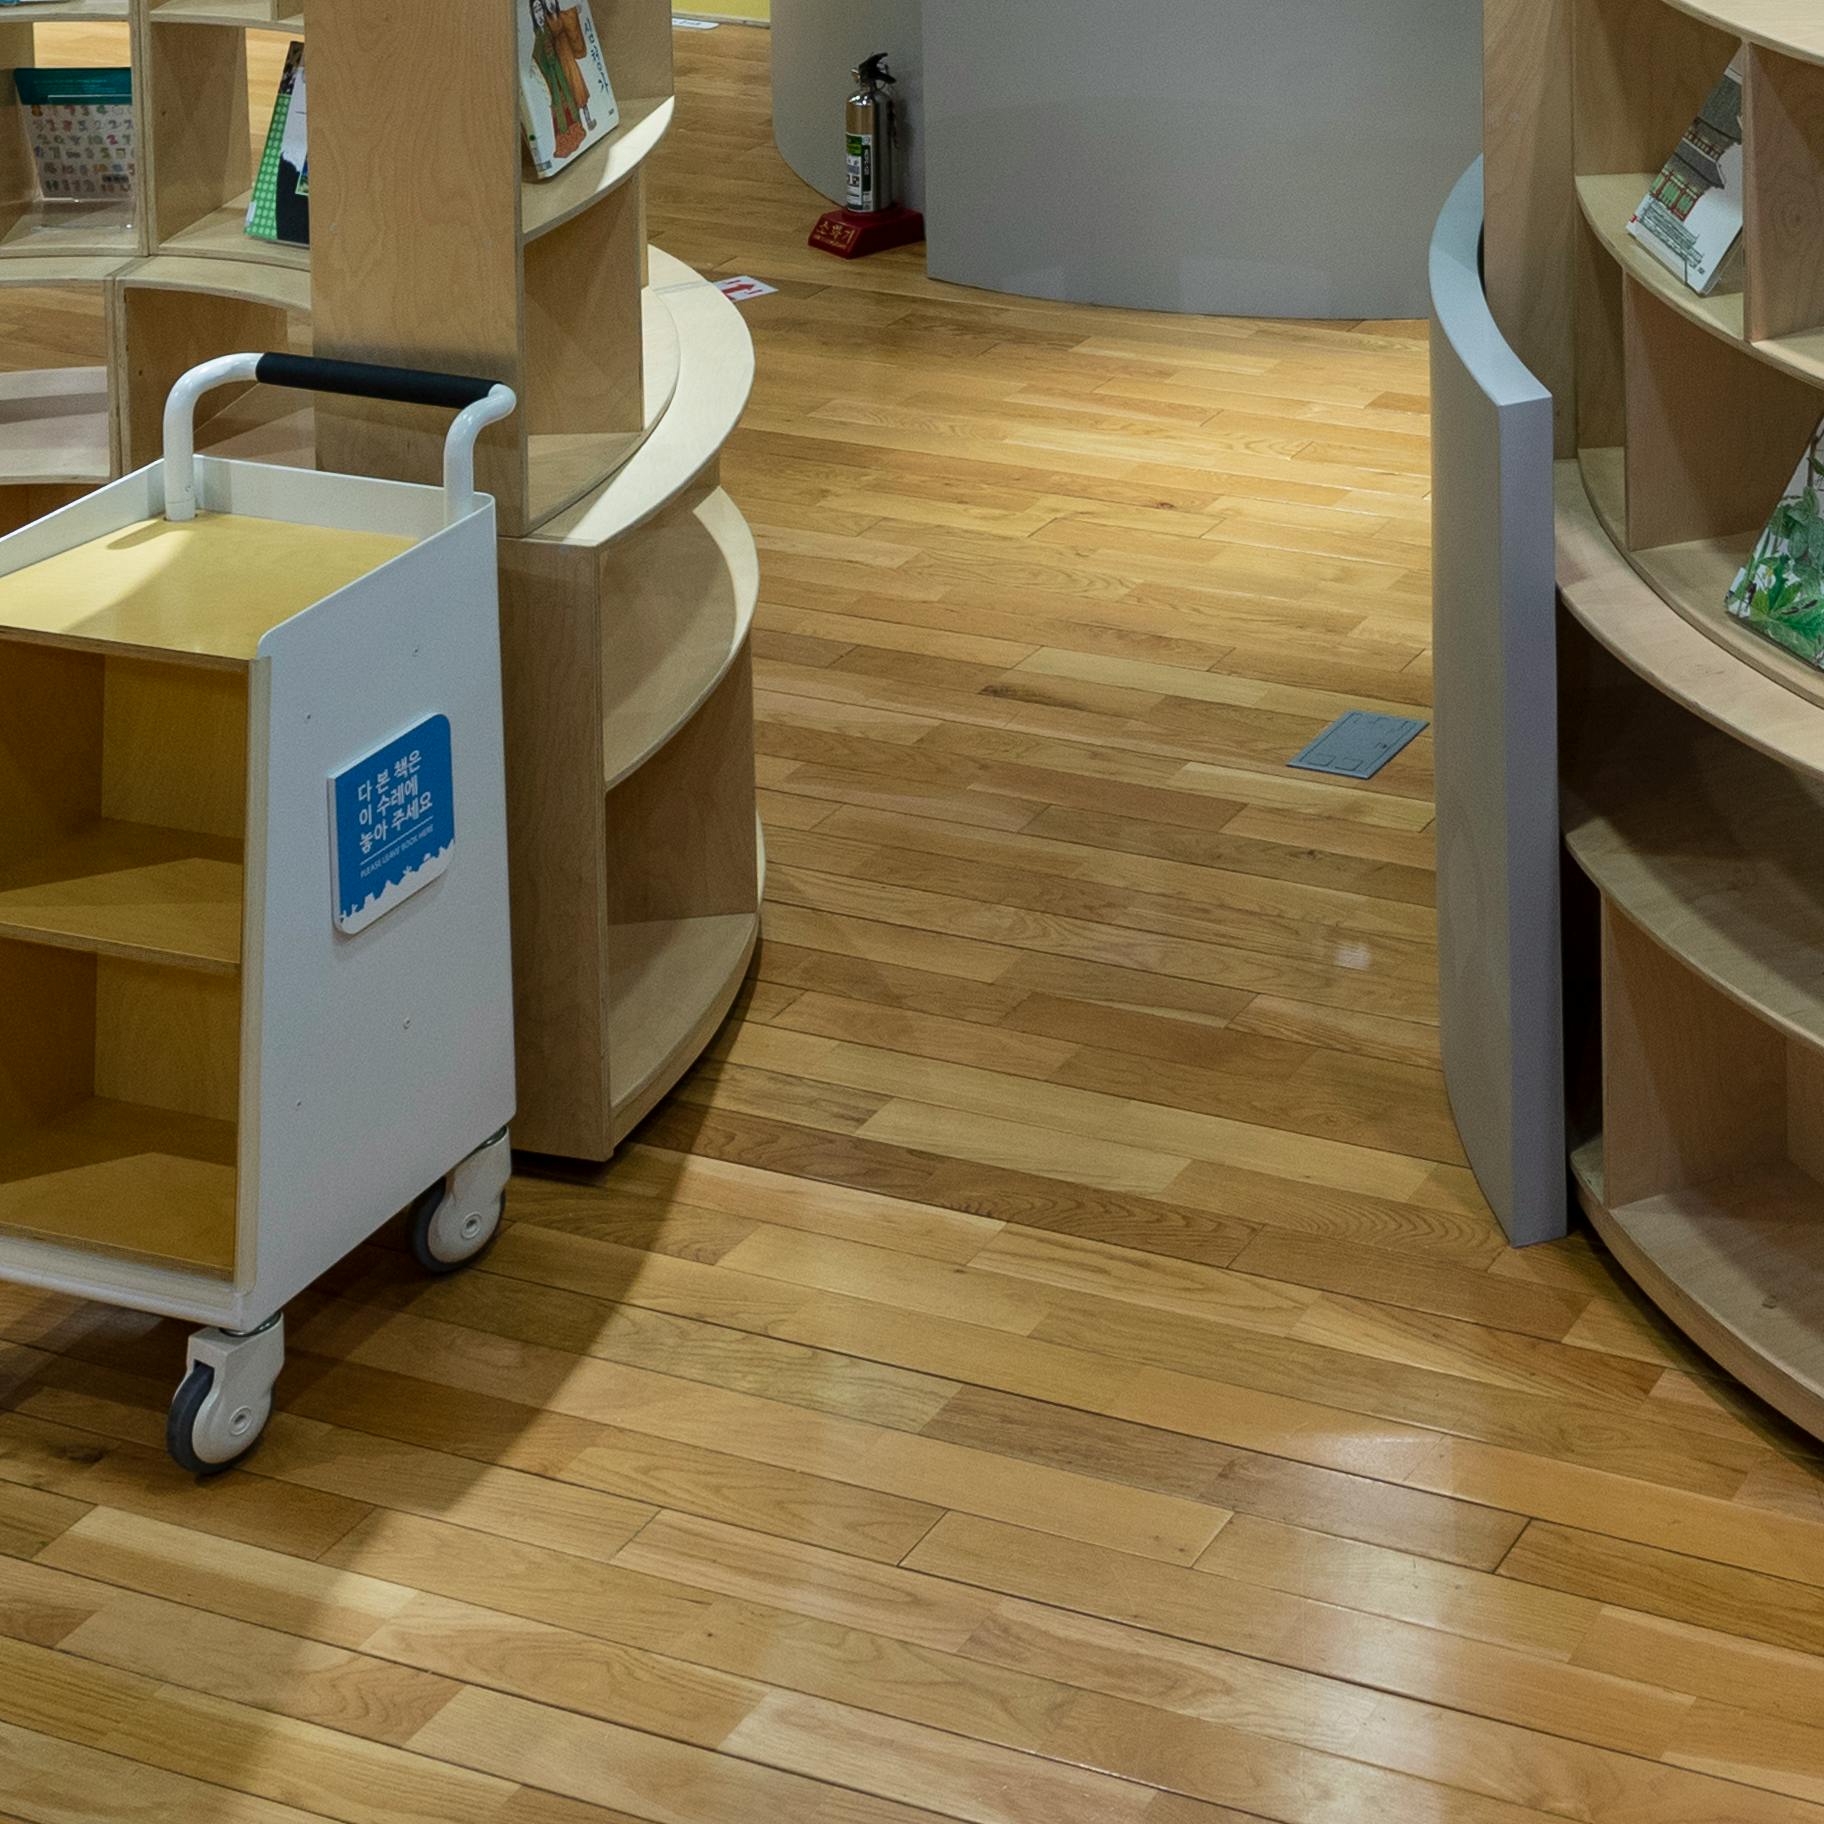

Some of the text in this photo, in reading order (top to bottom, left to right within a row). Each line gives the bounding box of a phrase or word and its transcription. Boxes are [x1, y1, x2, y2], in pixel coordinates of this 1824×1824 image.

[817, 220, 855, 243] 소화기
[358, 750, 422, 802] 다 본 책은
[359, 774, 418, 825] 이 수레에
[360, 791, 433, 854] 놓아 주세요
[360, 860, 382, 878] PLEASE
